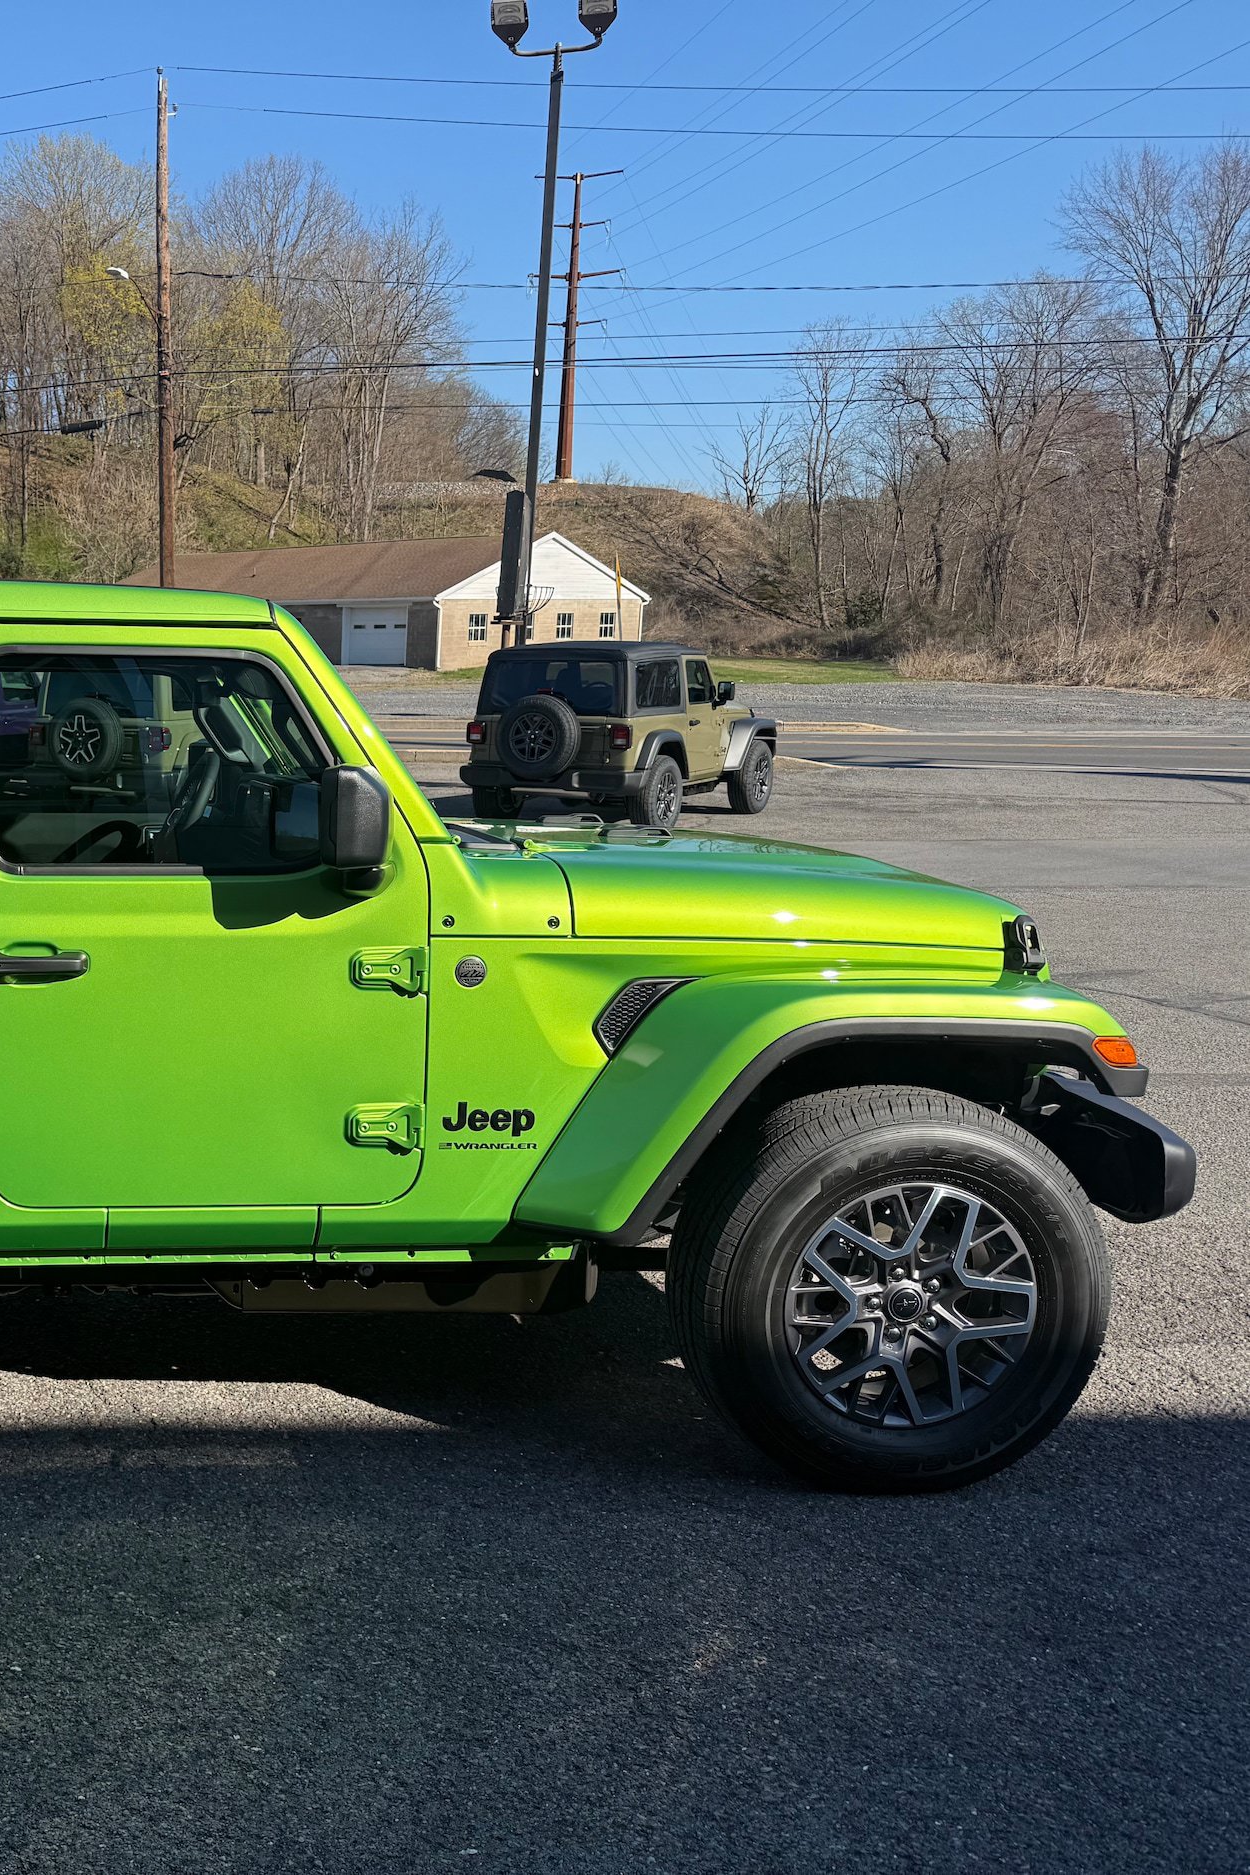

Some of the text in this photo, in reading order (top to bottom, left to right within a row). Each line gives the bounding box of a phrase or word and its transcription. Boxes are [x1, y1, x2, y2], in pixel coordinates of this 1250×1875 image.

[442, 1102, 536, 1137] Jeep
[453, 1142, 538, 1150] WRANGLER
[819, 1143, 1028, 1197] DUELER
